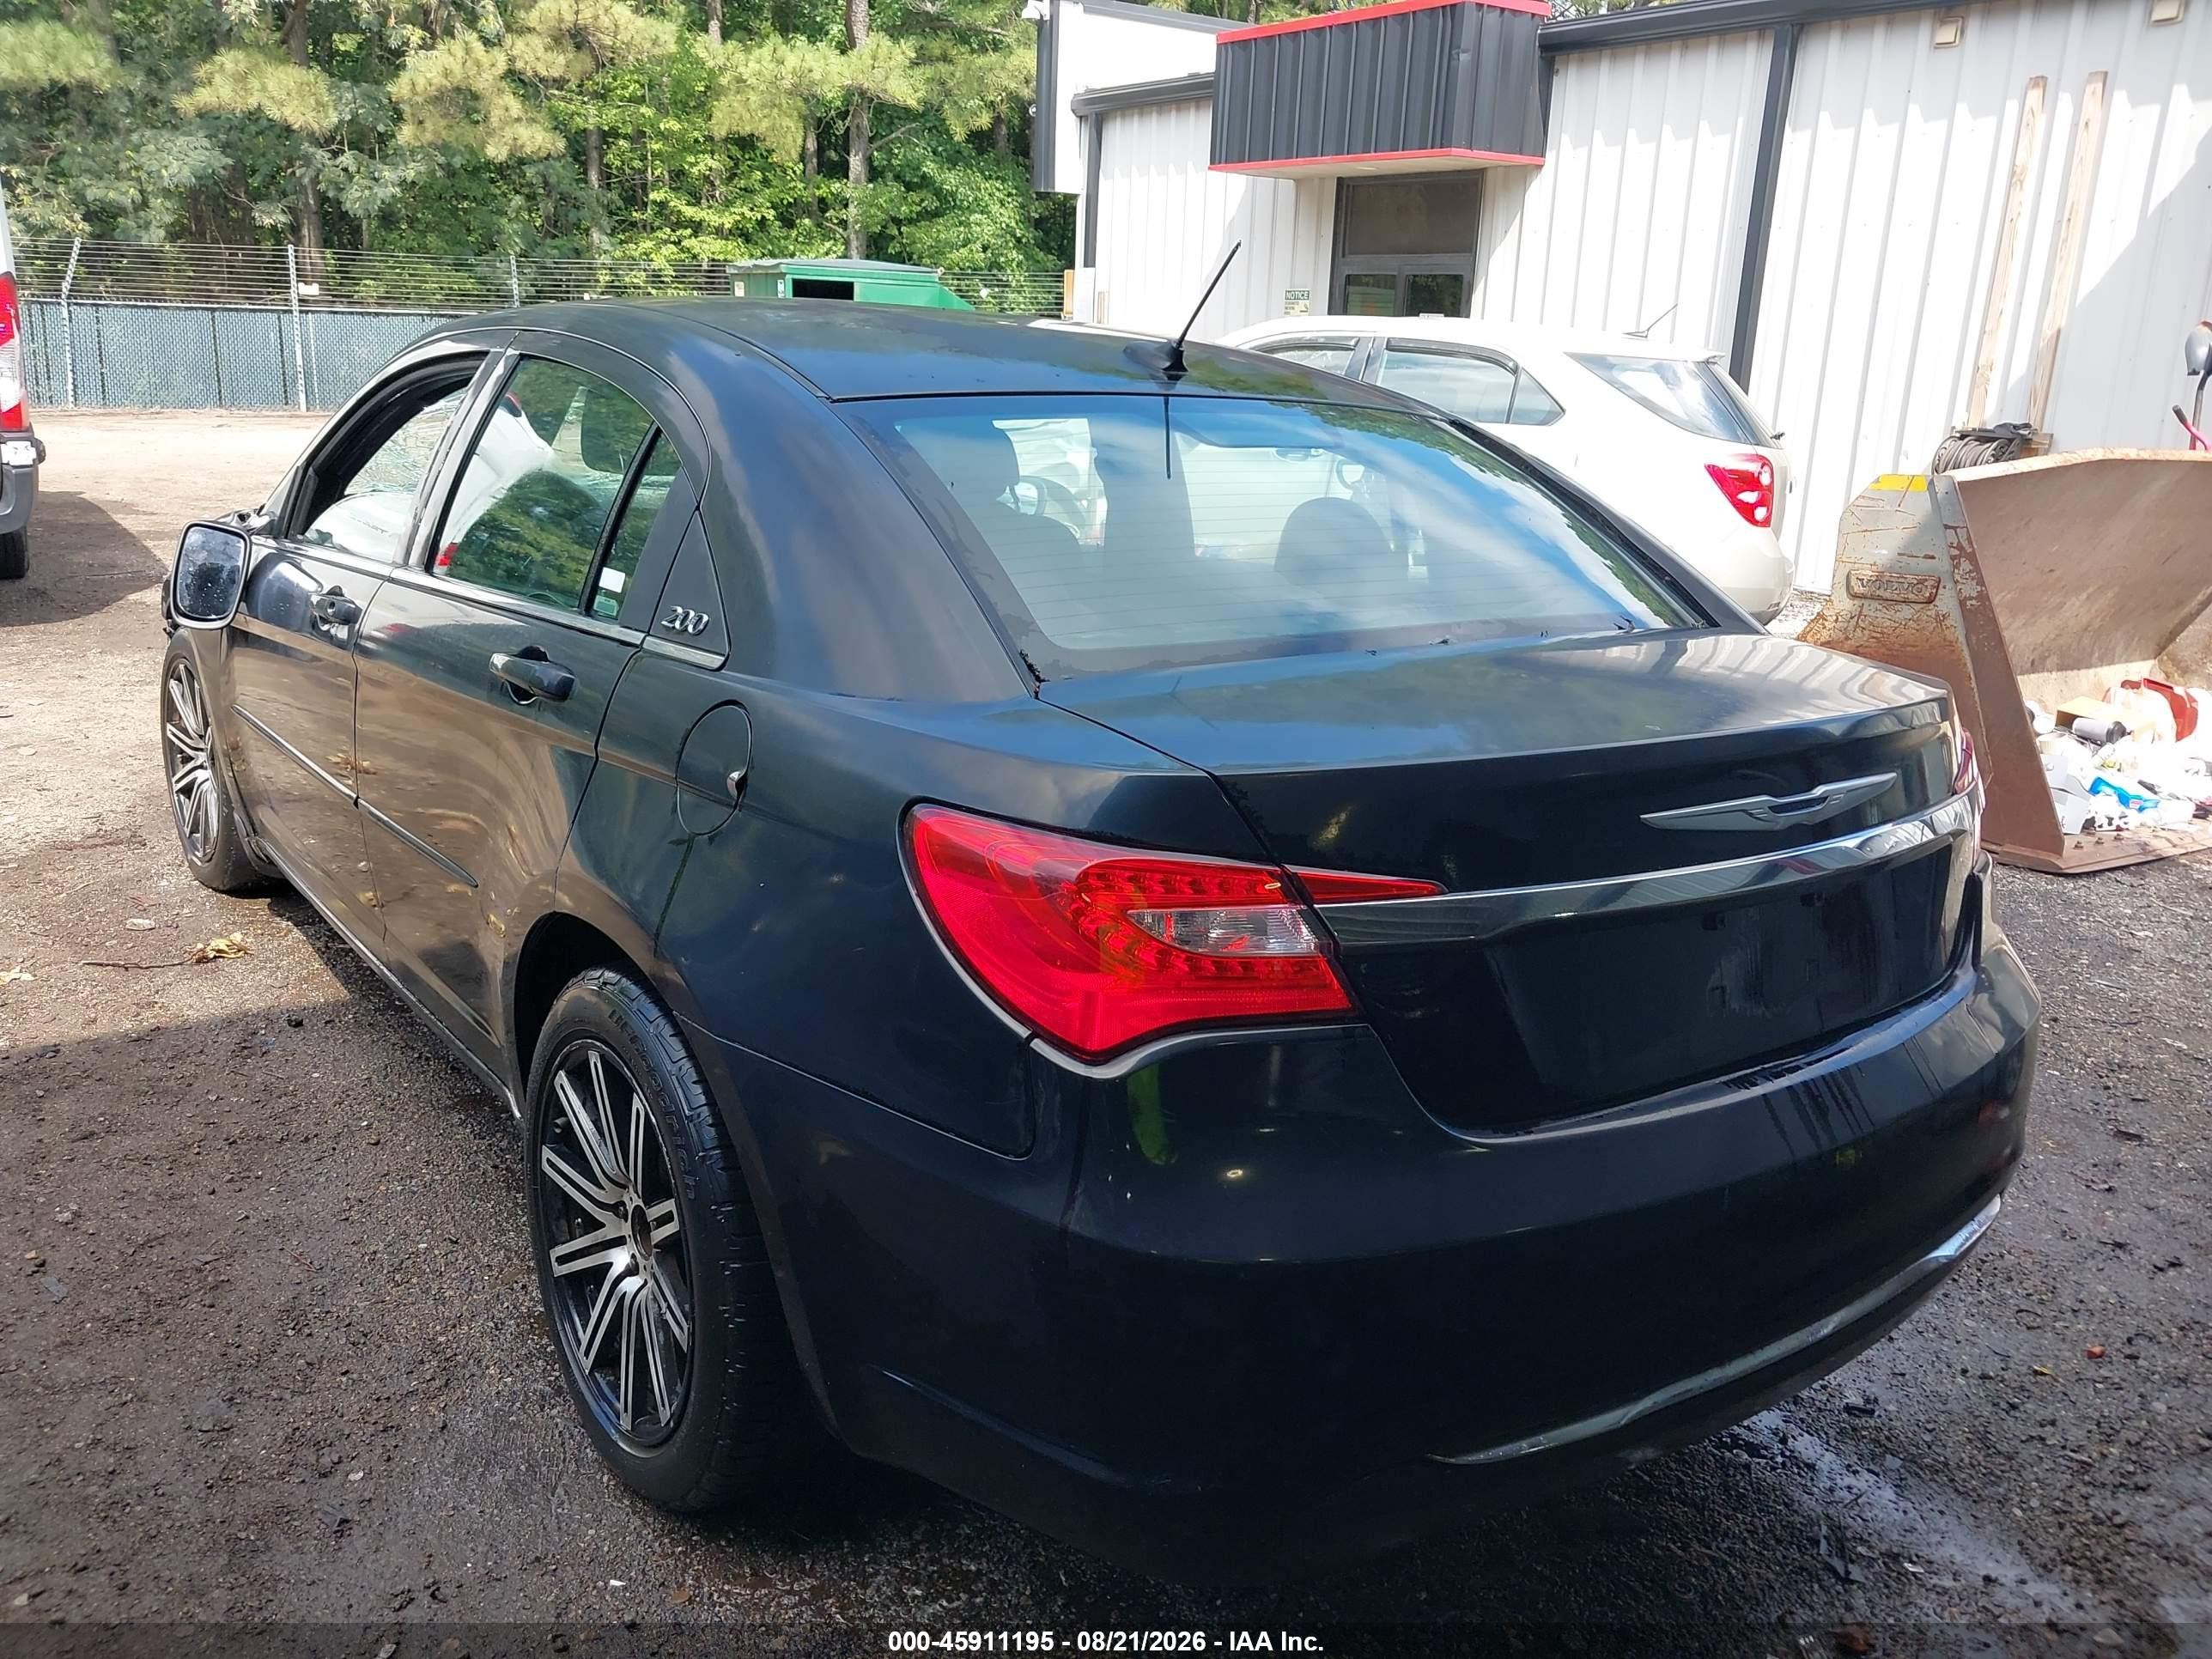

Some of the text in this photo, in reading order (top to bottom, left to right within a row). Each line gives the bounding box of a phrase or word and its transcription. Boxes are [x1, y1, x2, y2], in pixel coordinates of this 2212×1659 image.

[1286, 291, 1310, 300] NOTICE
[1856, 577, 1928, 594] VOLVO
[660, 605, 709, 635] 200
